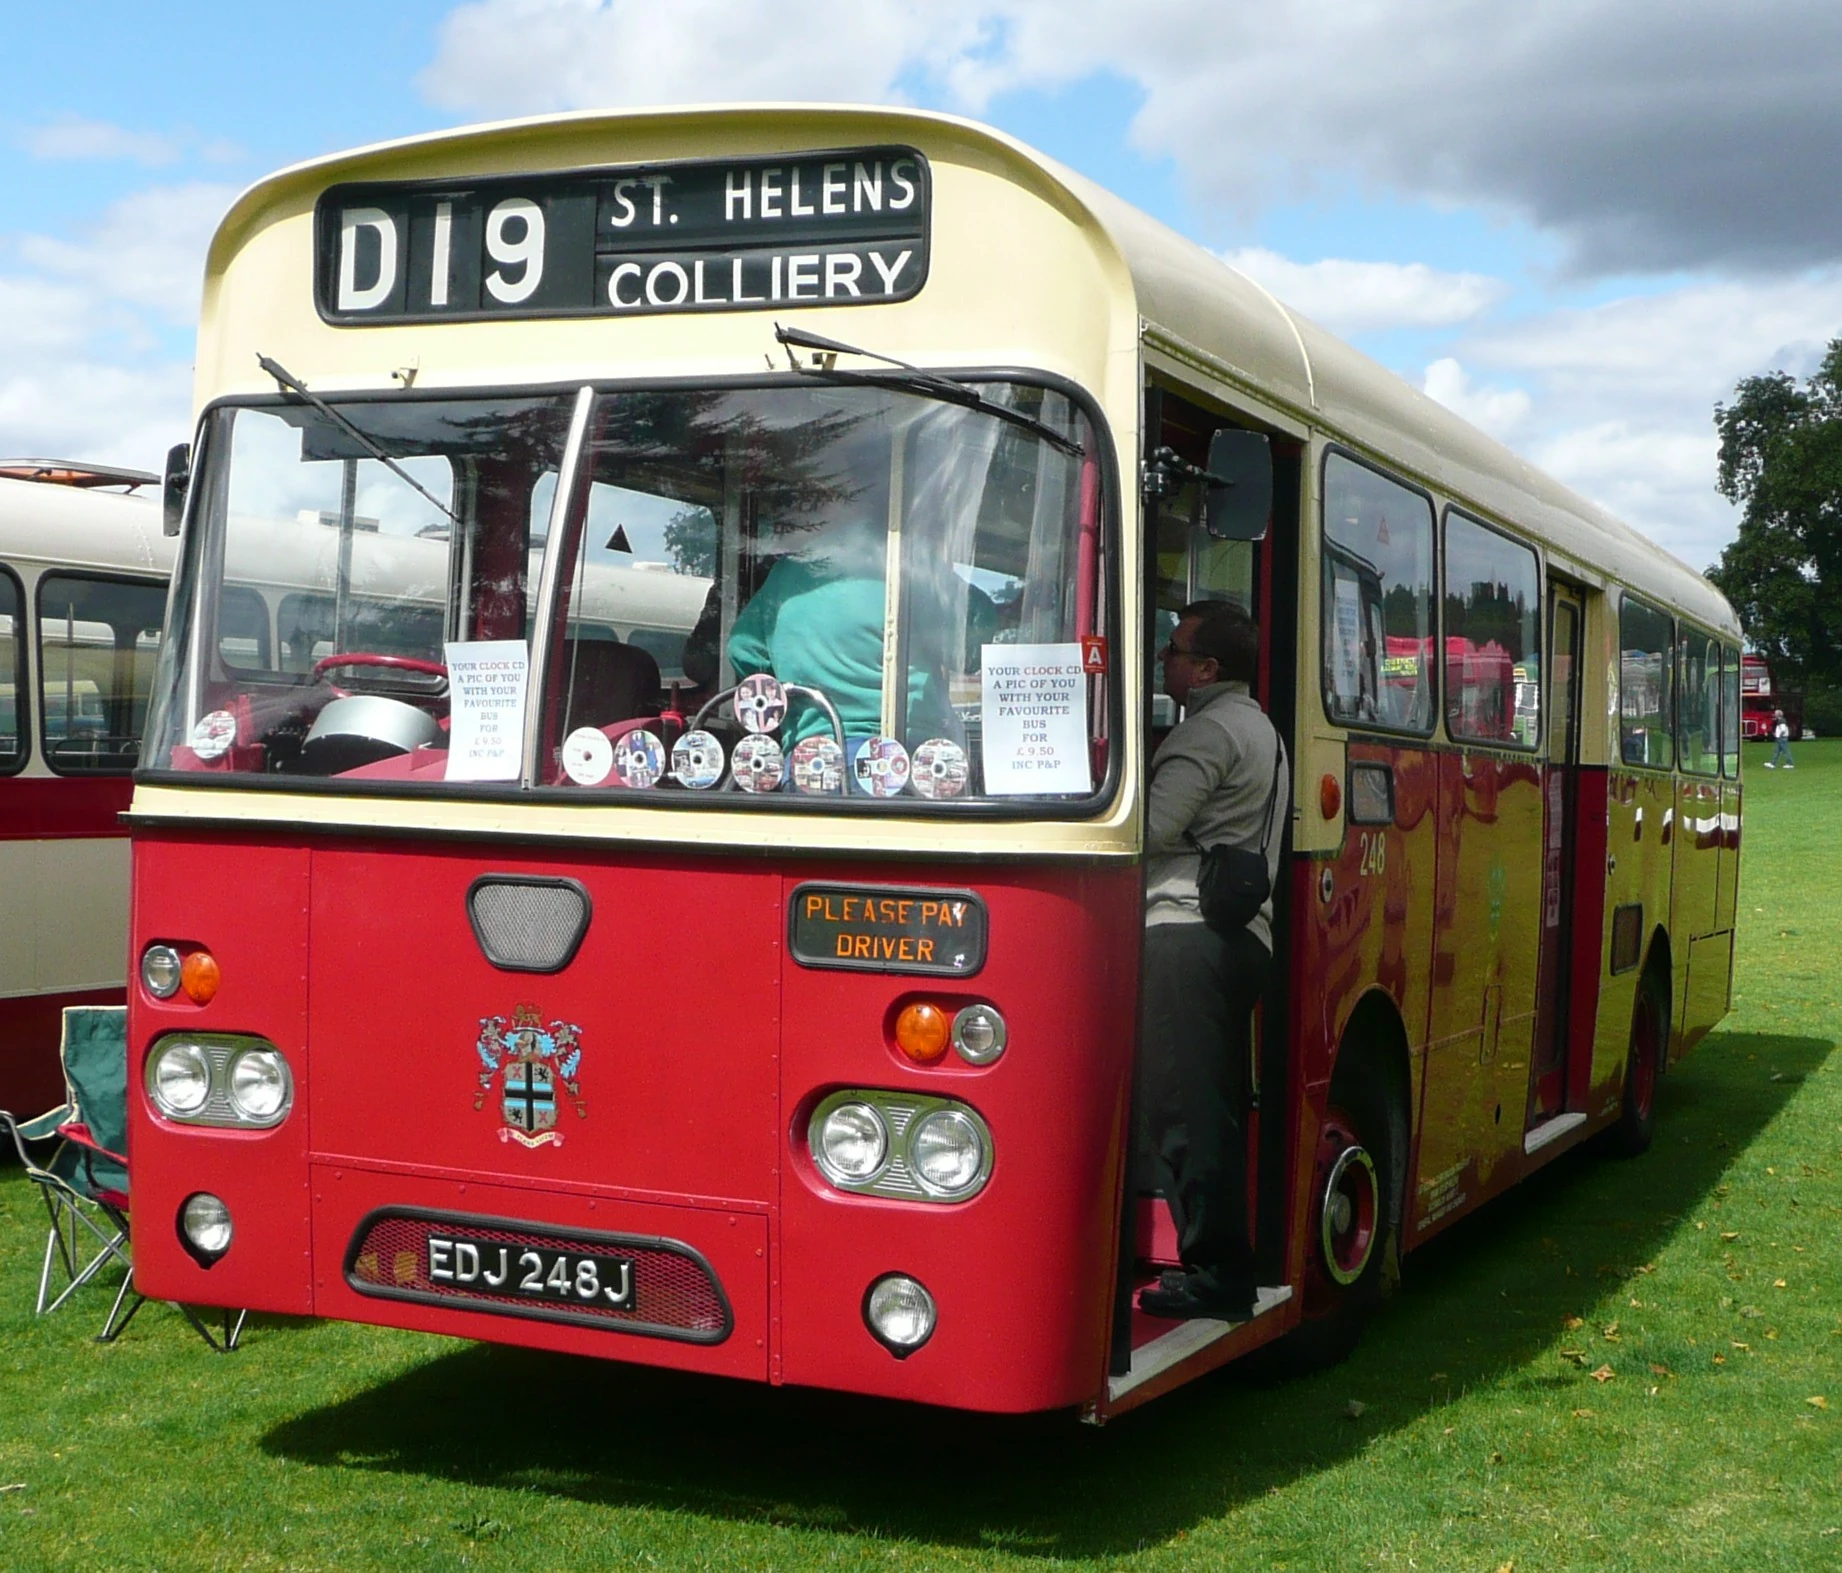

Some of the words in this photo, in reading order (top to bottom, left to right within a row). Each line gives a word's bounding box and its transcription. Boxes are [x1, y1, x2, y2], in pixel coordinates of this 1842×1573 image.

[611, 174, 679, 228] ST.
[725, 160, 916, 221] HELENS
[338, 197, 546, 311] D19
[607, 250, 913, 309] COLLIERY
[1088, 646, 1102, 664] A
[452, 662, 477, 671] YOUR
[479, 662, 509, 670] CLOCK
[512, 662, 525, 670] CD
[988, 666, 1020, 676] YOUR
[1024, 666, 1062, 675] CLOCK
[1066, 666, 1081, 674] CD
[458, 674, 464, 683] A
[467, 674, 482, 683] PIC
[485, 674, 498, 683] OF
[500, 674, 521, 683] YOU
[994, 680, 1002, 689] A
[1006, 680, 1026, 689] PIC
[1030, 680, 1047, 688] OF
[1050, 679, 1076, 688] YOU
[463, 686, 488, 695] WITH
[490, 686, 517, 695] YOUR
[999, 693, 1031, 702] WITH
[1036, 692, 1070, 702] YOUR
[464, 699, 517, 708] FAVOURITE
[480, 712, 498, 720] BUS
[999, 706, 1070, 716] FAVOURITE
[480, 724, 498, 733] FOR
[1022, 720, 1046, 729] BUS
[1022, 733, 1048, 742] FOR
[1012, 760, 1033, 770] INC
[1037, 760, 1062, 769] P&P
[1360, 831, 1386, 876] 248
[806, 896, 912, 924] PLEASE
[922, 902, 968, 927] PAY
[836, 934, 934, 961] DRIVER
[429, 1239, 507, 1286] EDJ
[519, 1251, 629, 1303] 248J
